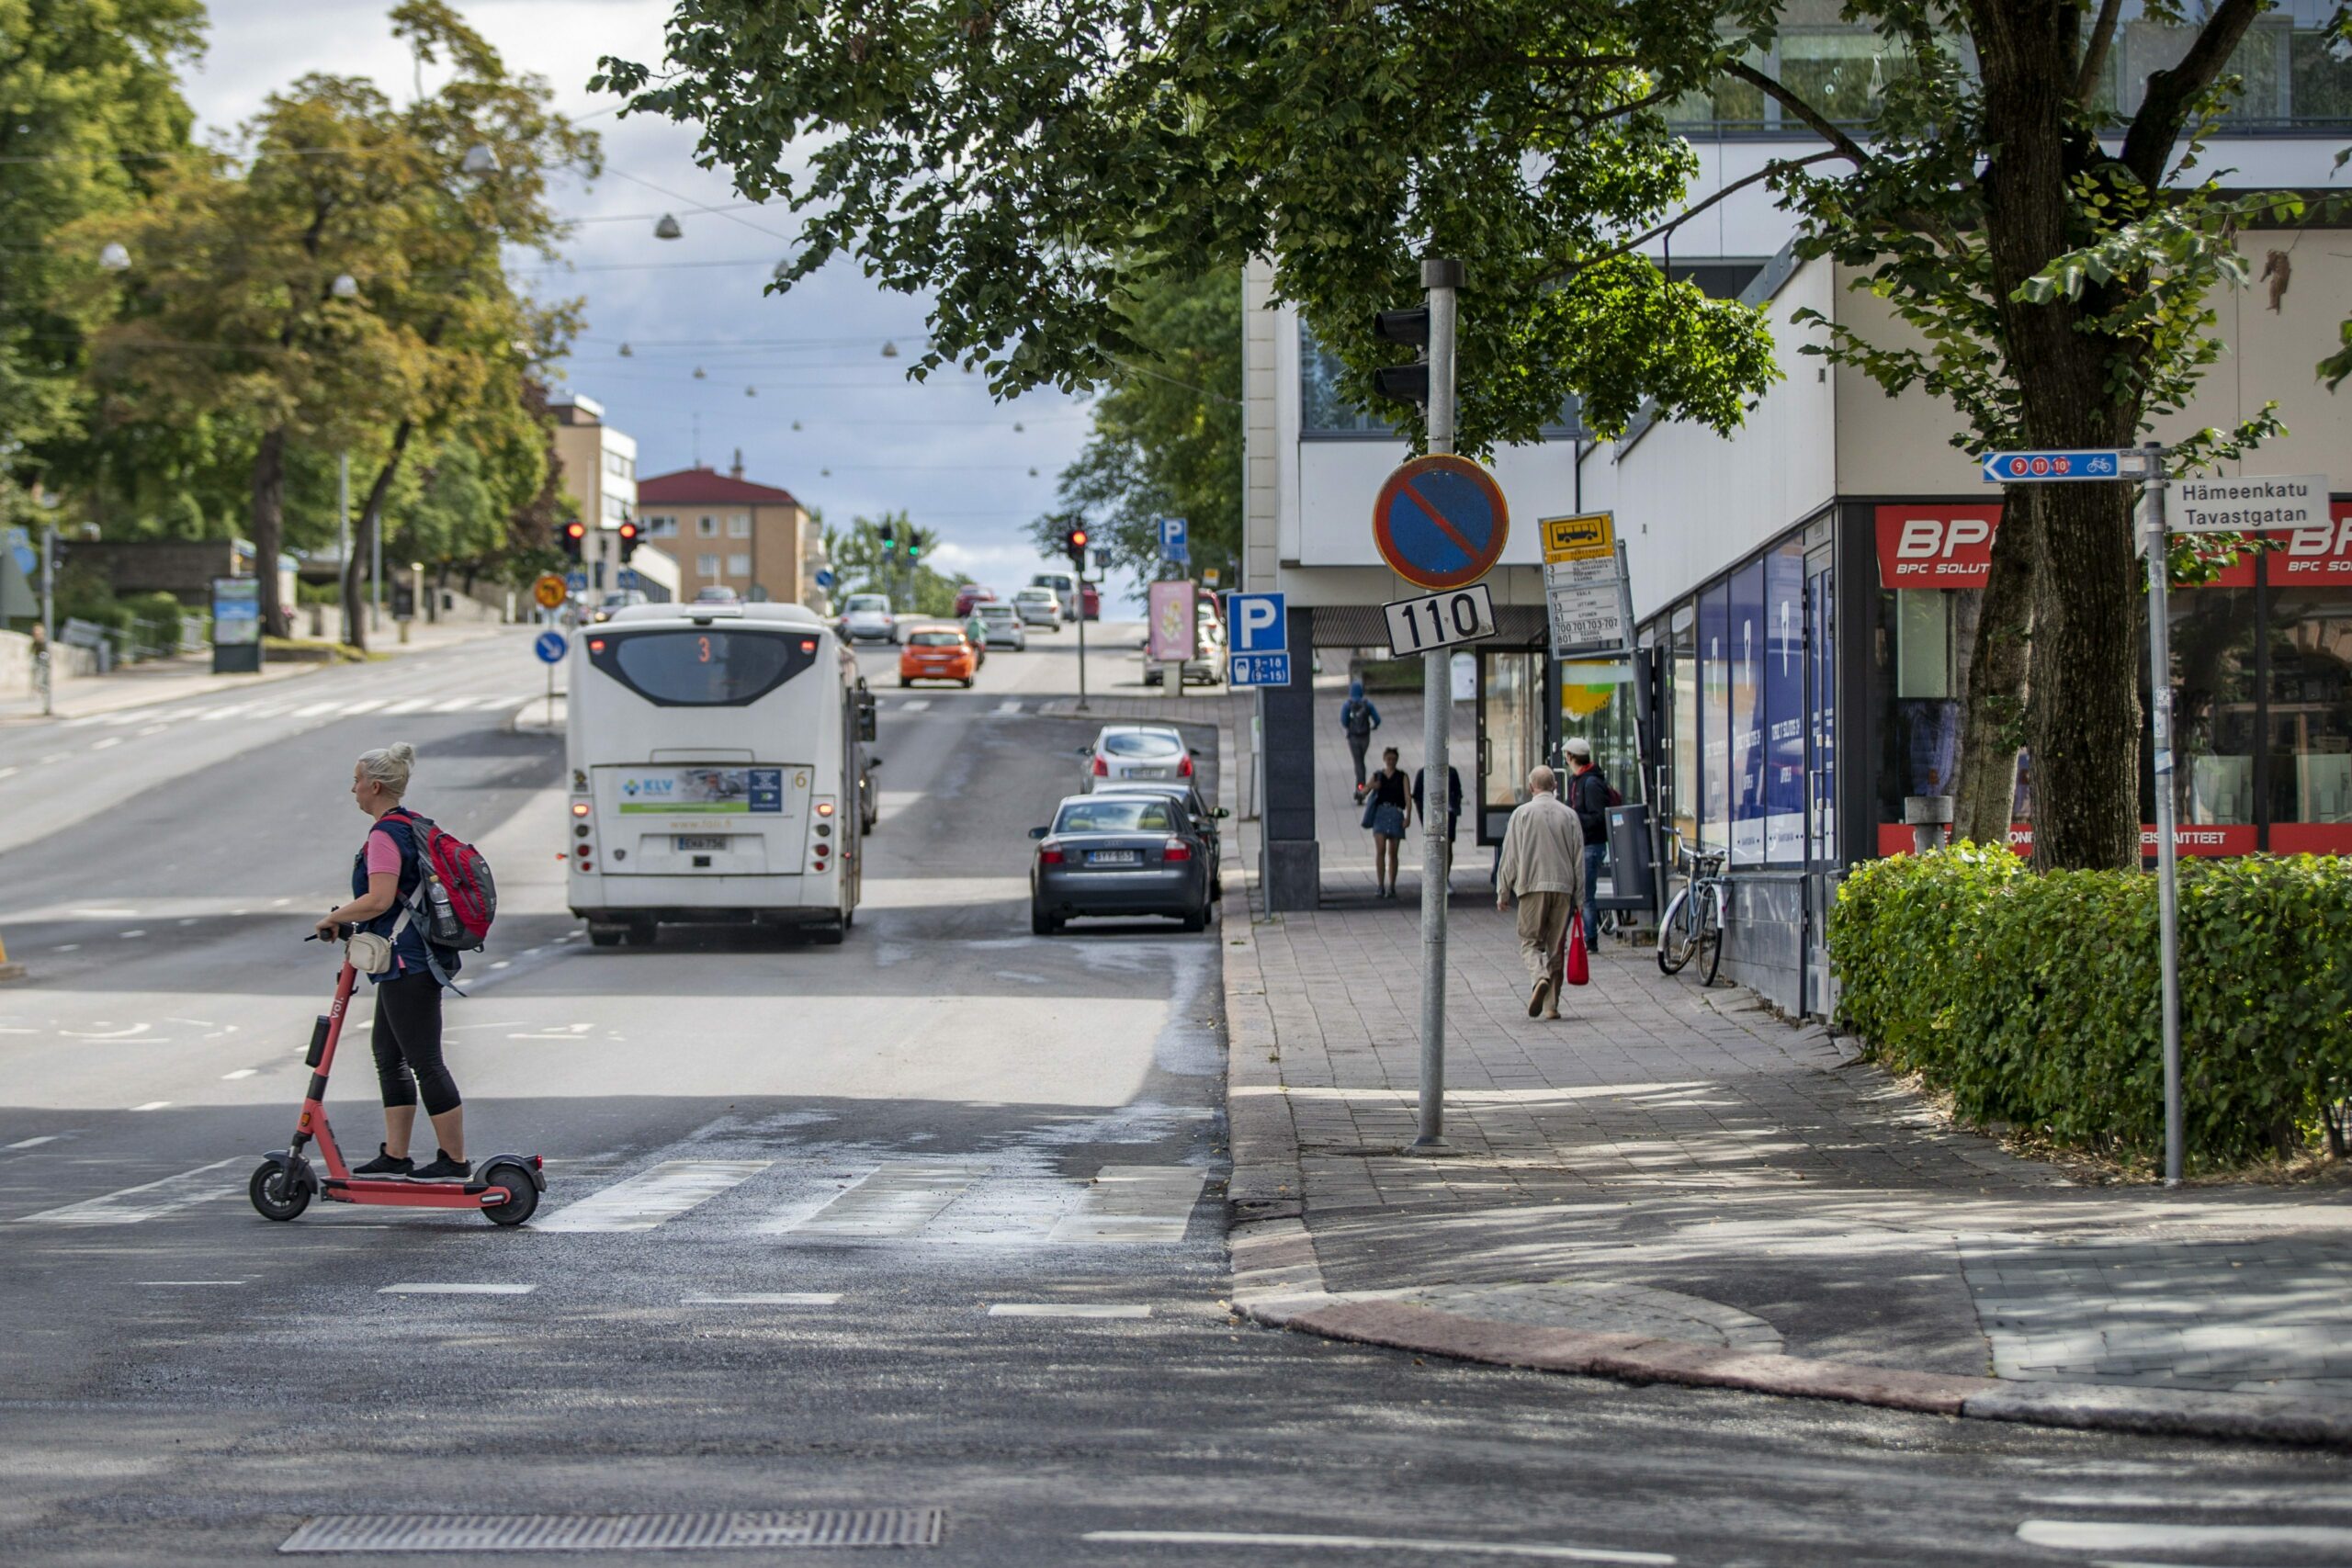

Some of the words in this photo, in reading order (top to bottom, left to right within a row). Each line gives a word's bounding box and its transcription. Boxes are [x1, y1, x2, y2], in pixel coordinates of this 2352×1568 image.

[2016, 462, 2022, 470] 9
[2036, 461, 2045, 471] 11
[2054, 460, 2065, 470] 10
[2183, 482, 2308, 502] Hämeenkatu
[2185, 509, 2307, 527] Tavastgatan
[1164, 520, 1182, 543] P
[1896, 519, 1998, 558] BP
[1549, 565, 1555, 573] 3
[1896, 563, 1928, 574] BPC
[1935, 563, 1991, 574] SOLUT
[2288, 561, 2321, 571] BPC
[1552, 592, 1558, 601] 9
[1554, 603, 1563, 612] 13
[1401, 593, 1479, 648] 110
[1555, 613, 1564, 622] 61
[1240, 598, 1276, 649] P
[1556, 624, 1572, 633] 700
[1573, 622, 1586, 631] 701
[1557, 635, 1572, 644] 801
[698, 637, 711, 662] 3
[643, 779, 673, 791] KLV
[795, 771, 807, 788] 6
